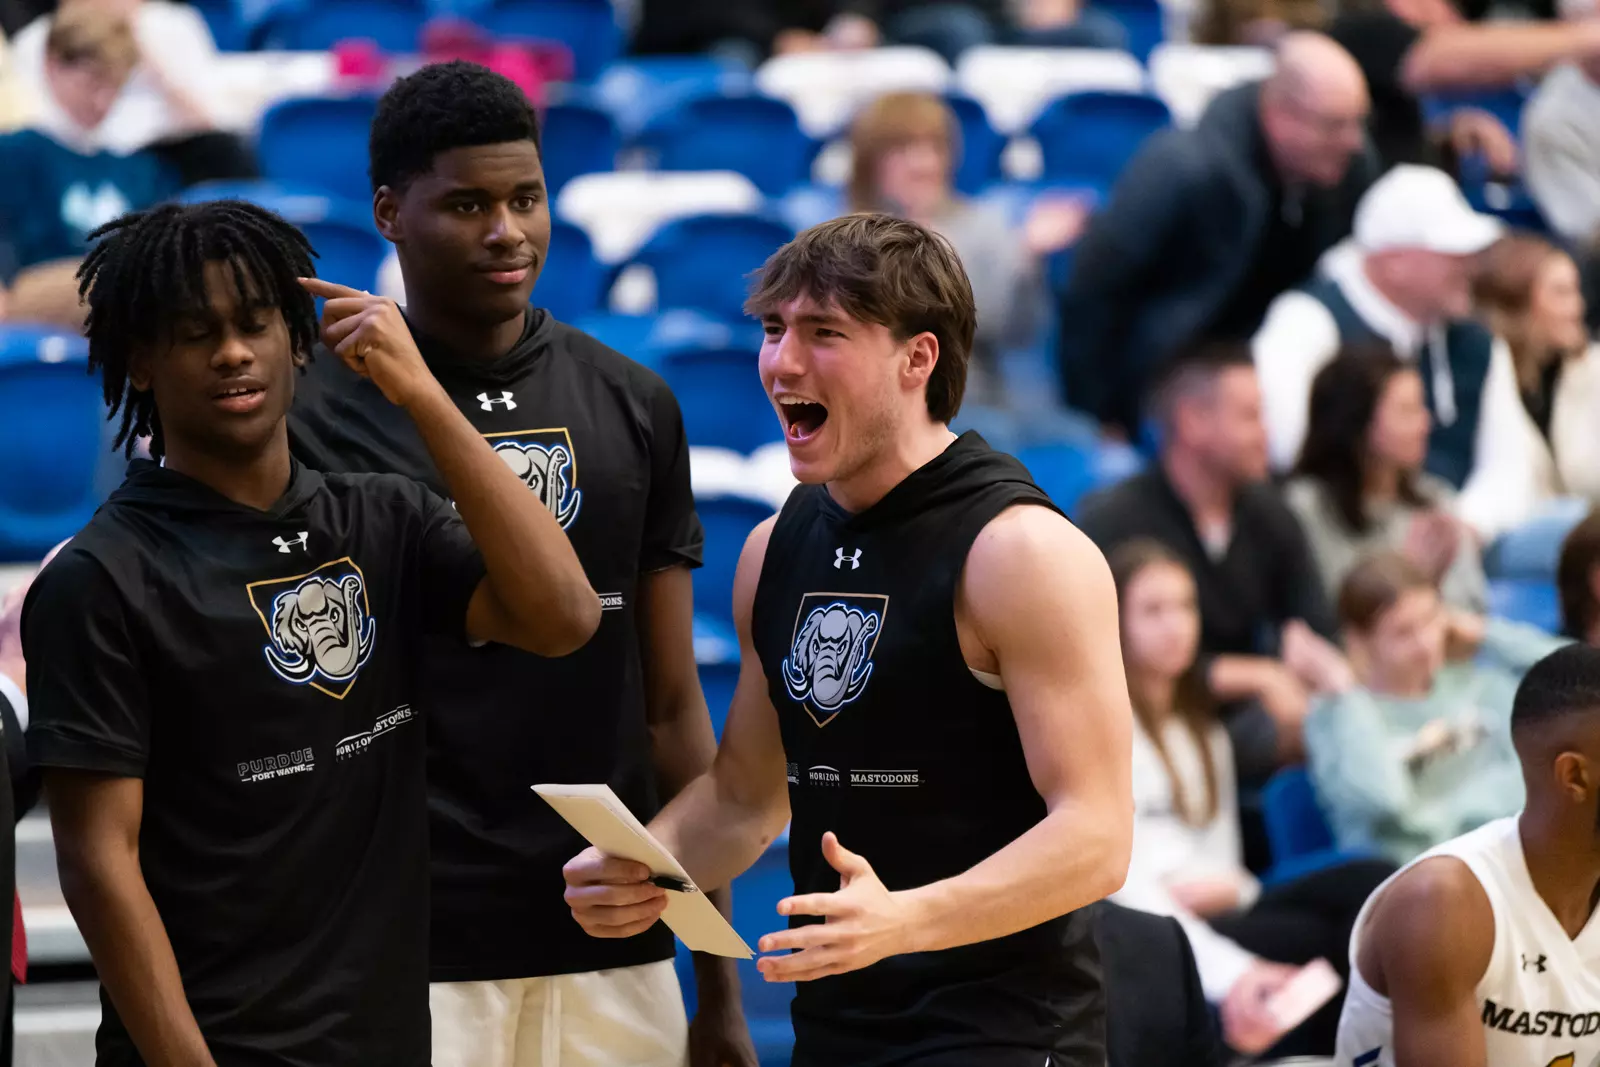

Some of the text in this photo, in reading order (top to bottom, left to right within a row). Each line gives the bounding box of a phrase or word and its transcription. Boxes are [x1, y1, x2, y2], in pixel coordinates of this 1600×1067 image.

[236, 747, 315, 777] PURDUE
[251, 763, 306, 782] FORT WAYNE
[809, 772, 840, 782] HORIZON
[850, 774, 919, 783] MASTODONS
[1481, 998, 1600, 1038] MASTOD
